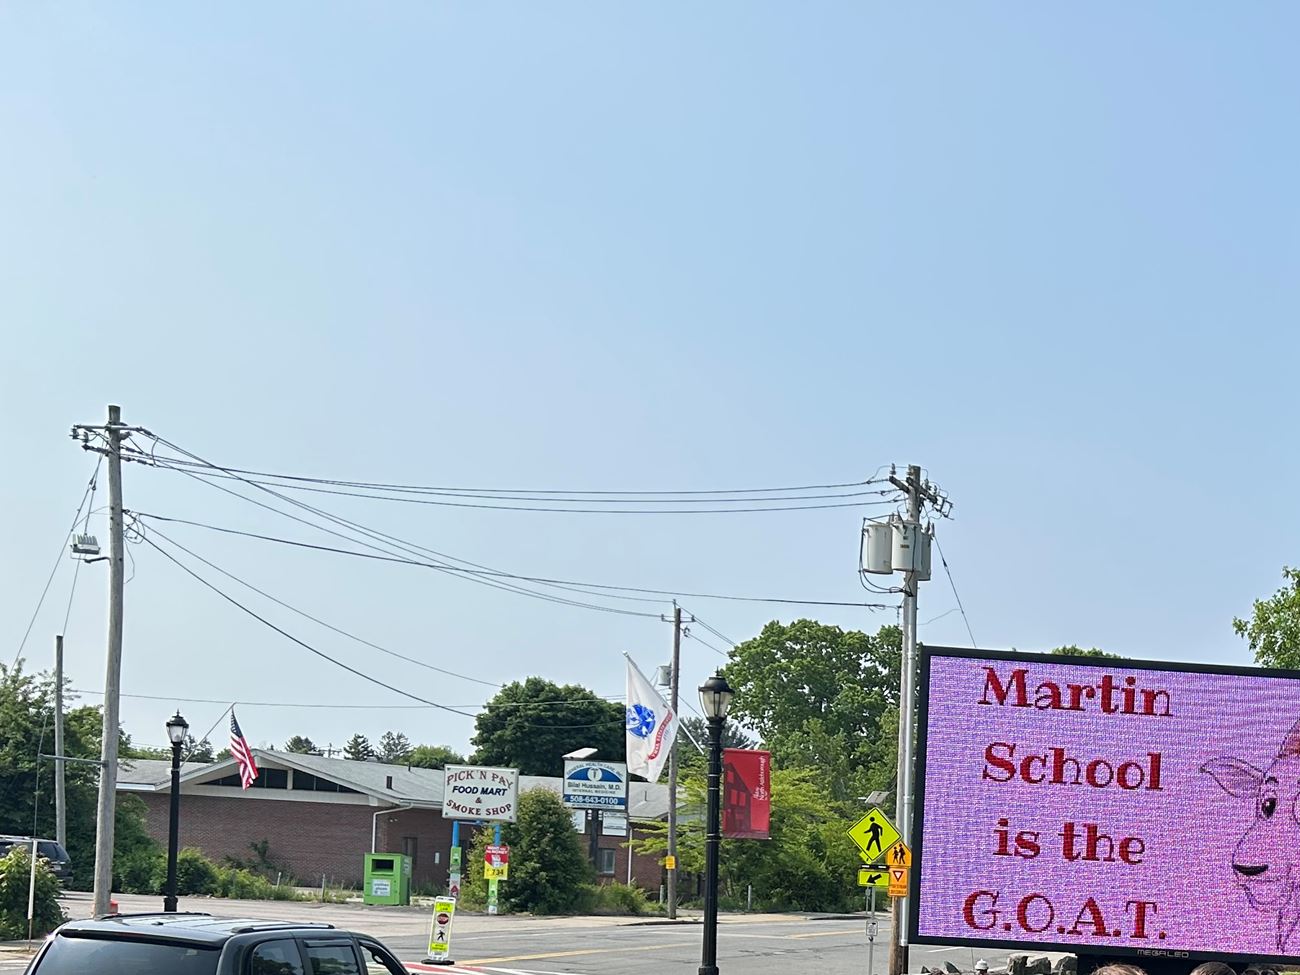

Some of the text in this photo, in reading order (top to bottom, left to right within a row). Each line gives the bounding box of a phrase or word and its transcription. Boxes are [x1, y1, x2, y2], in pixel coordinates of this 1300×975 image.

[977, 666, 1174, 717] Martin
[447, 770, 474, 786] PICK
[491, 773, 514, 789] PAY
[982, 742, 1163, 791] School
[452, 785, 508, 796] FOOD MART
[570, 795, 618, 805] 508-643-0100
[446, 799, 512, 816] SMOKE SHOP
[993, 818, 1146, 865] is the
[962, 890, 1167, 940] G.O.A.T.
